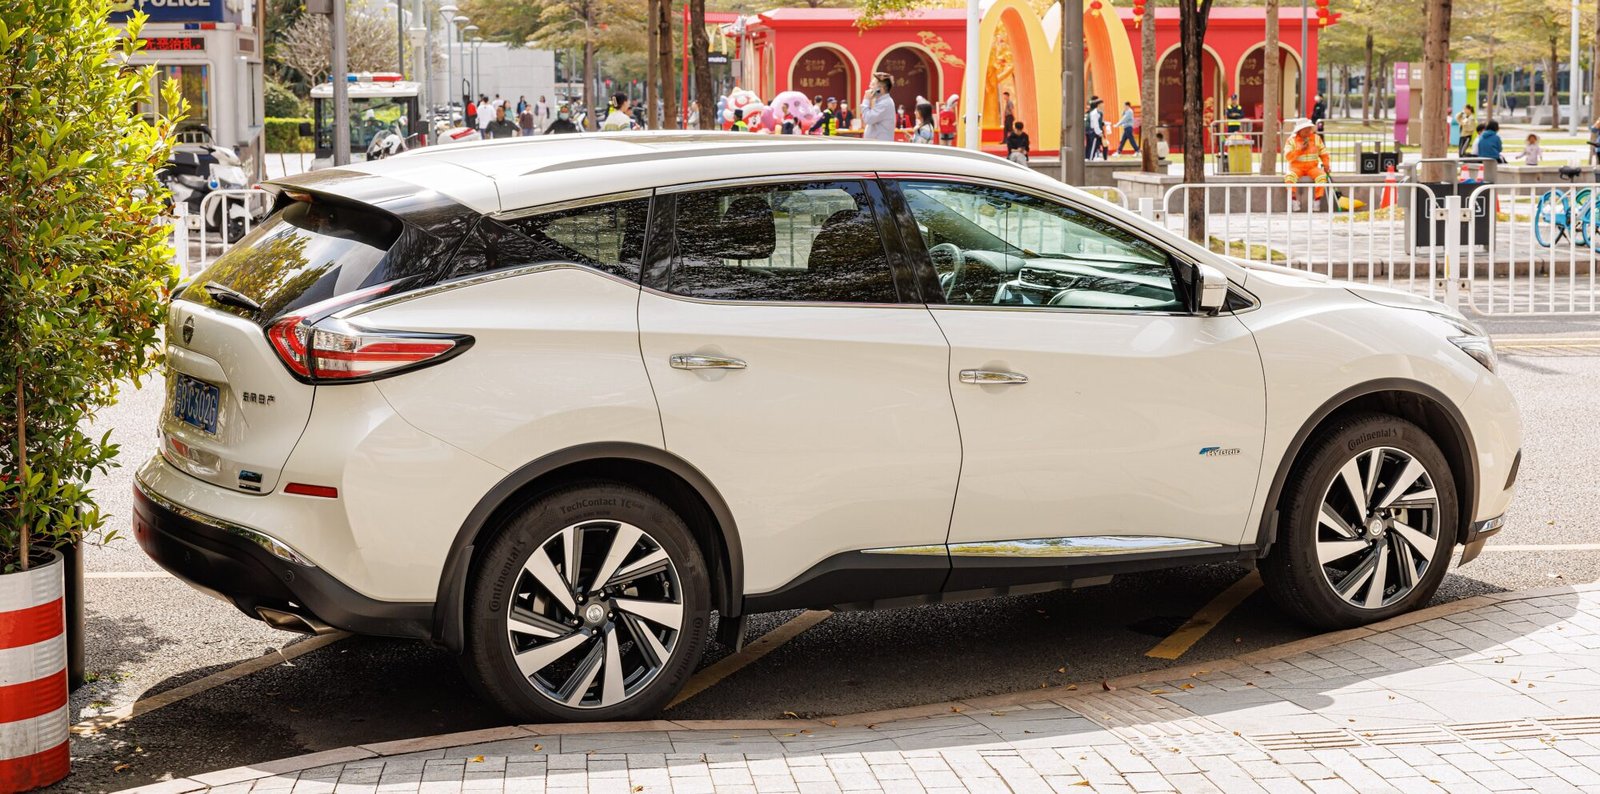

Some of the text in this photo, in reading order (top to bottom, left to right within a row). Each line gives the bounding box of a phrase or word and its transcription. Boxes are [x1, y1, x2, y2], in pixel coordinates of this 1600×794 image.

[243, 391, 276, 405] 东风日产
[1347, 428, 1391, 451] Continental
[560, 498, 616, 514] TechContact
[488, 545, 521, 612] Continental
